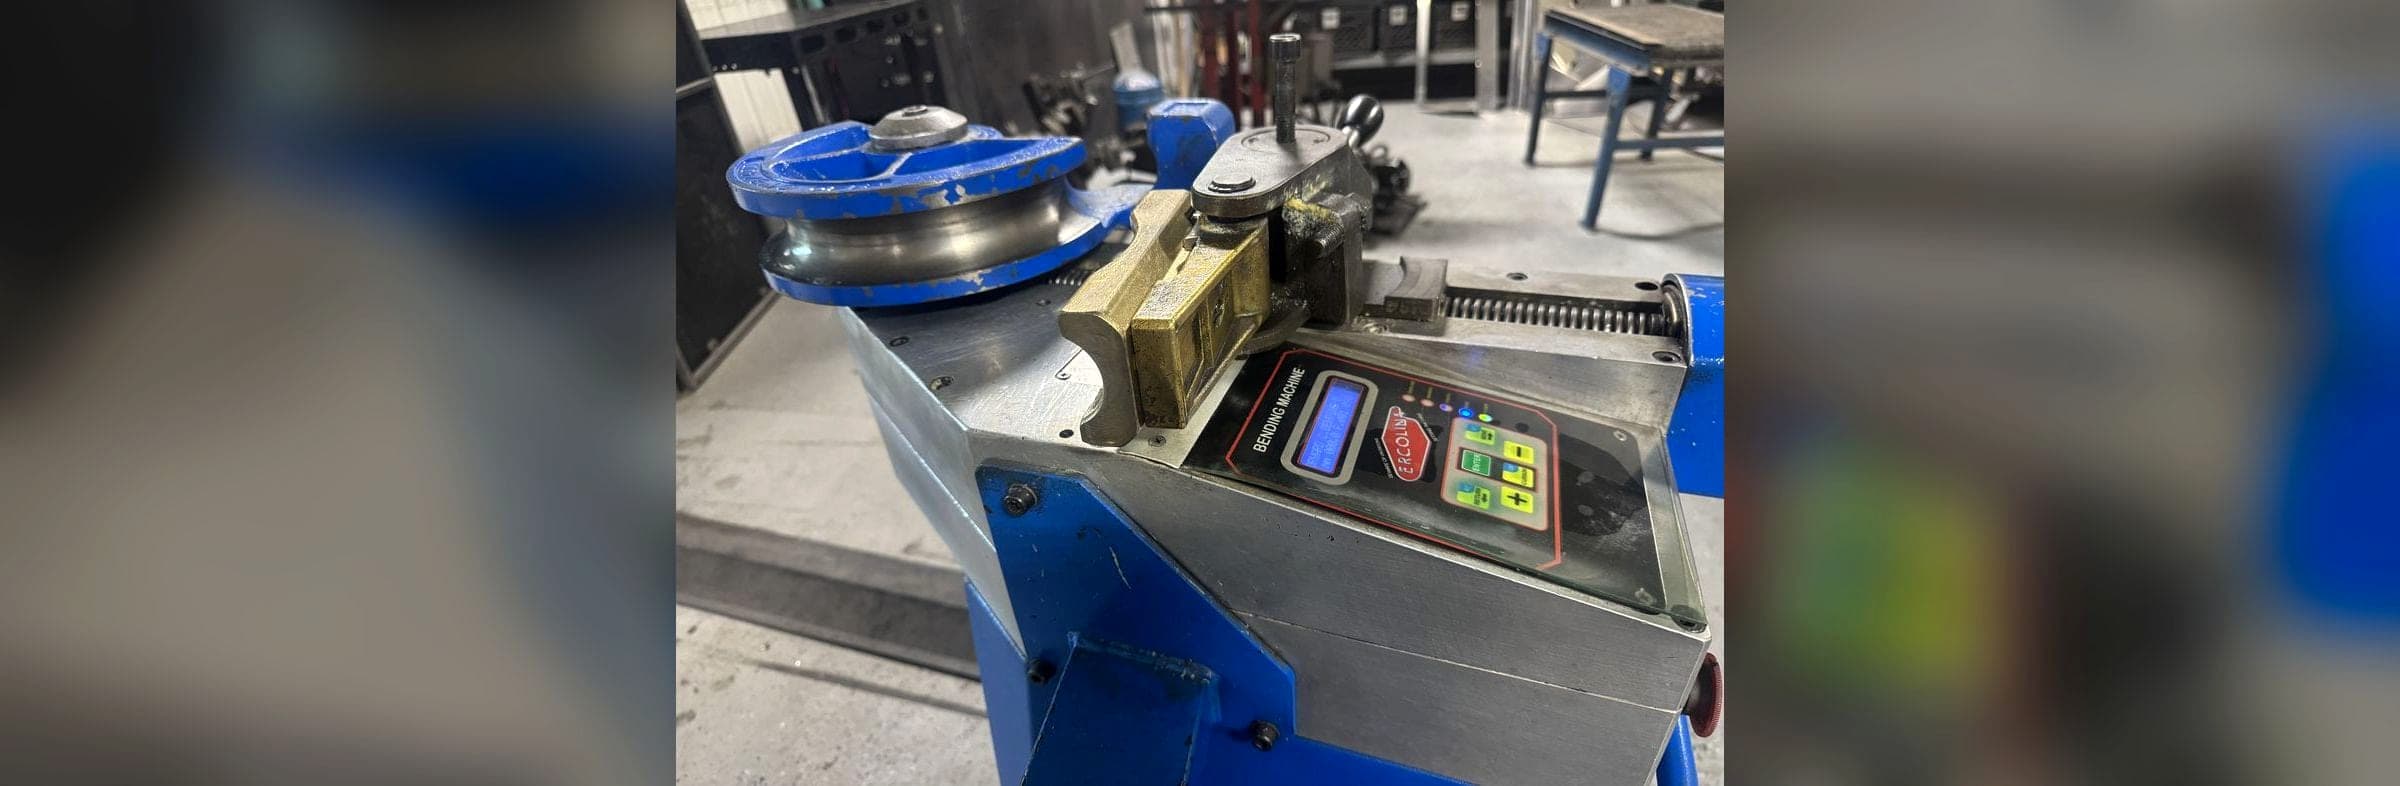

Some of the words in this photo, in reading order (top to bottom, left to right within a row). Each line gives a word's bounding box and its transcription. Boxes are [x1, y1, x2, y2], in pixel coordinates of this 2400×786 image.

[1253, 407, 1285, 453] BENDING
[1278, 367, 1305, 407] MACHINE
[1472, 454, 1481, 472] ENTER
